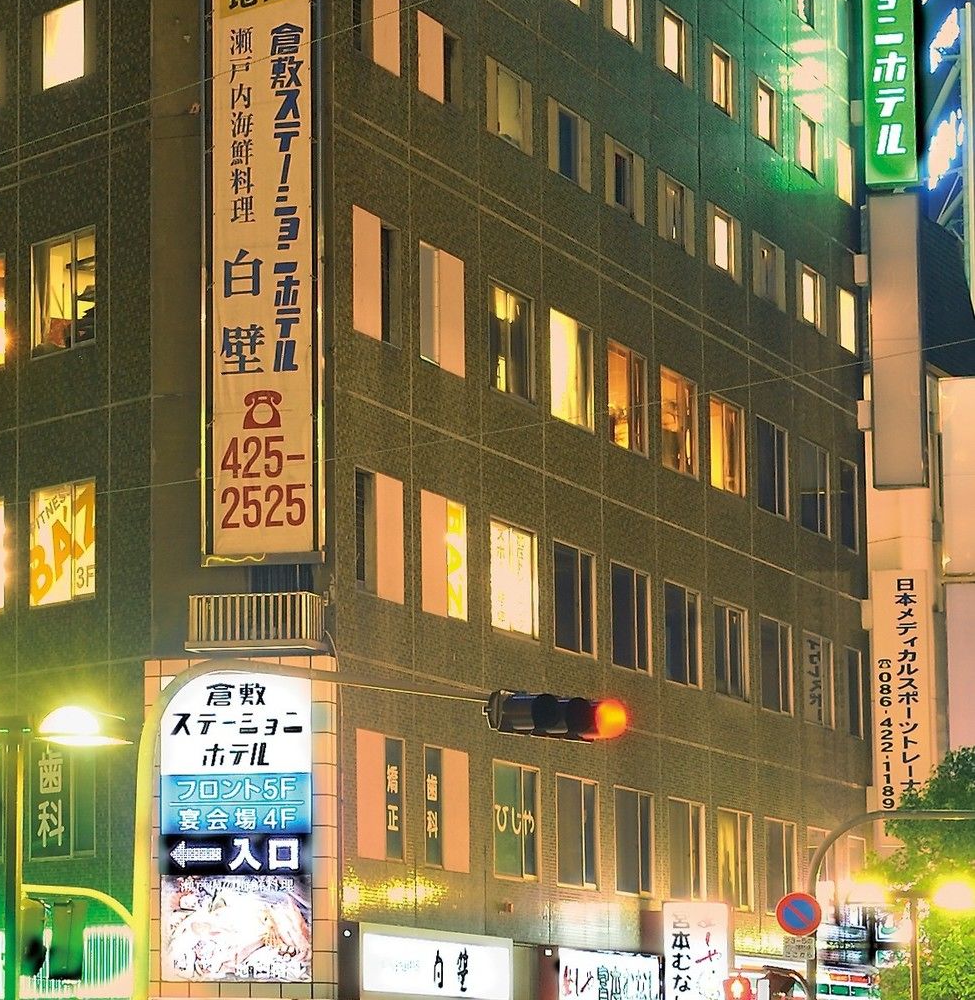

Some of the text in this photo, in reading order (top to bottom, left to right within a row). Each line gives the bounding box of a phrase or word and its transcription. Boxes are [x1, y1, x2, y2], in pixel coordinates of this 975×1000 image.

[229, 26, 256, 224] 瀬戸内海鮮料理
[219, 248, 265, 376] 白壁
[220, 435, 306, 478] 425-
[220, 483, 306, 529] 2525
[206, 682, 267, 707] 倉敷
[201, 741, 271, 768] ホテル
[228, 836, 300, 872] 入口
